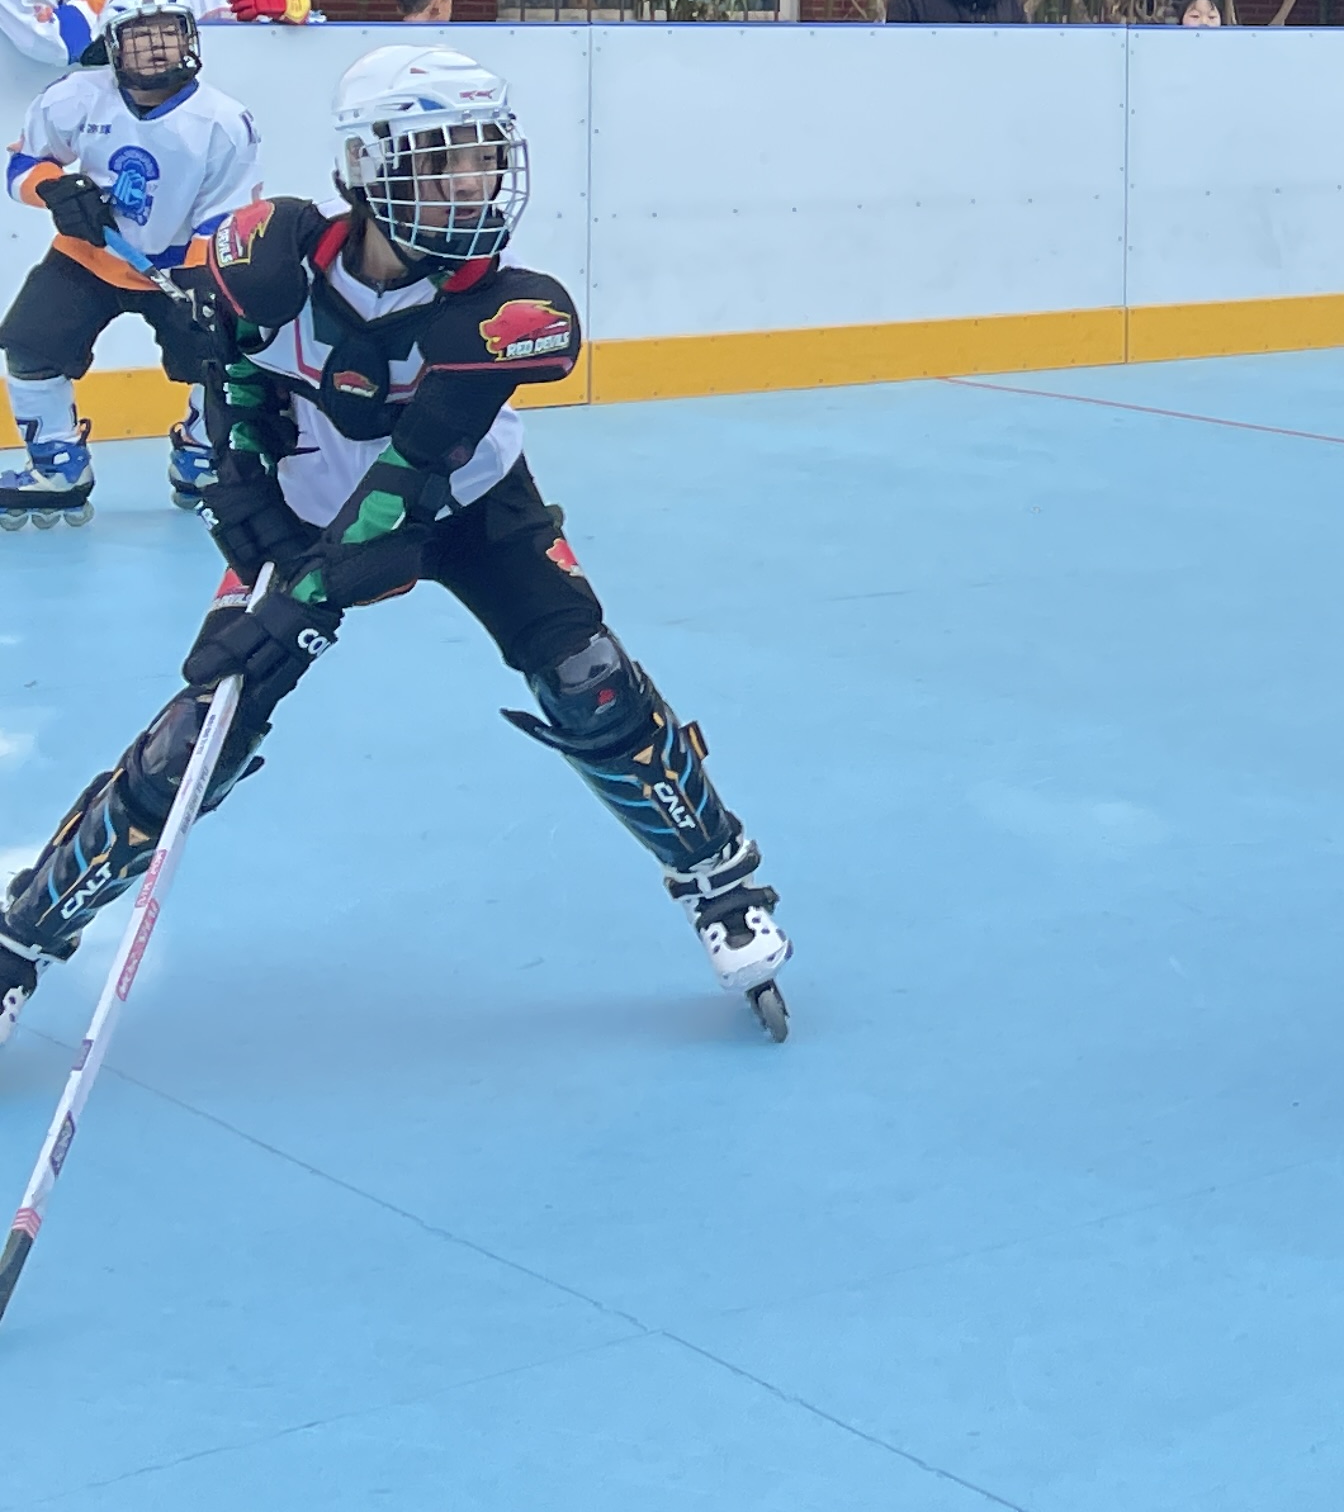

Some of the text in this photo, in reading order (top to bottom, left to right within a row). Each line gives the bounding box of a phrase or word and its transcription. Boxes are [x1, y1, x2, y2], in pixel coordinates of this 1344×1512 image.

[507, 340, 533, 357] RED
[297, 628, 336, 656] CO
[654, 782, 695, 829] CALT
[61, 861, 112, 919] CALT
